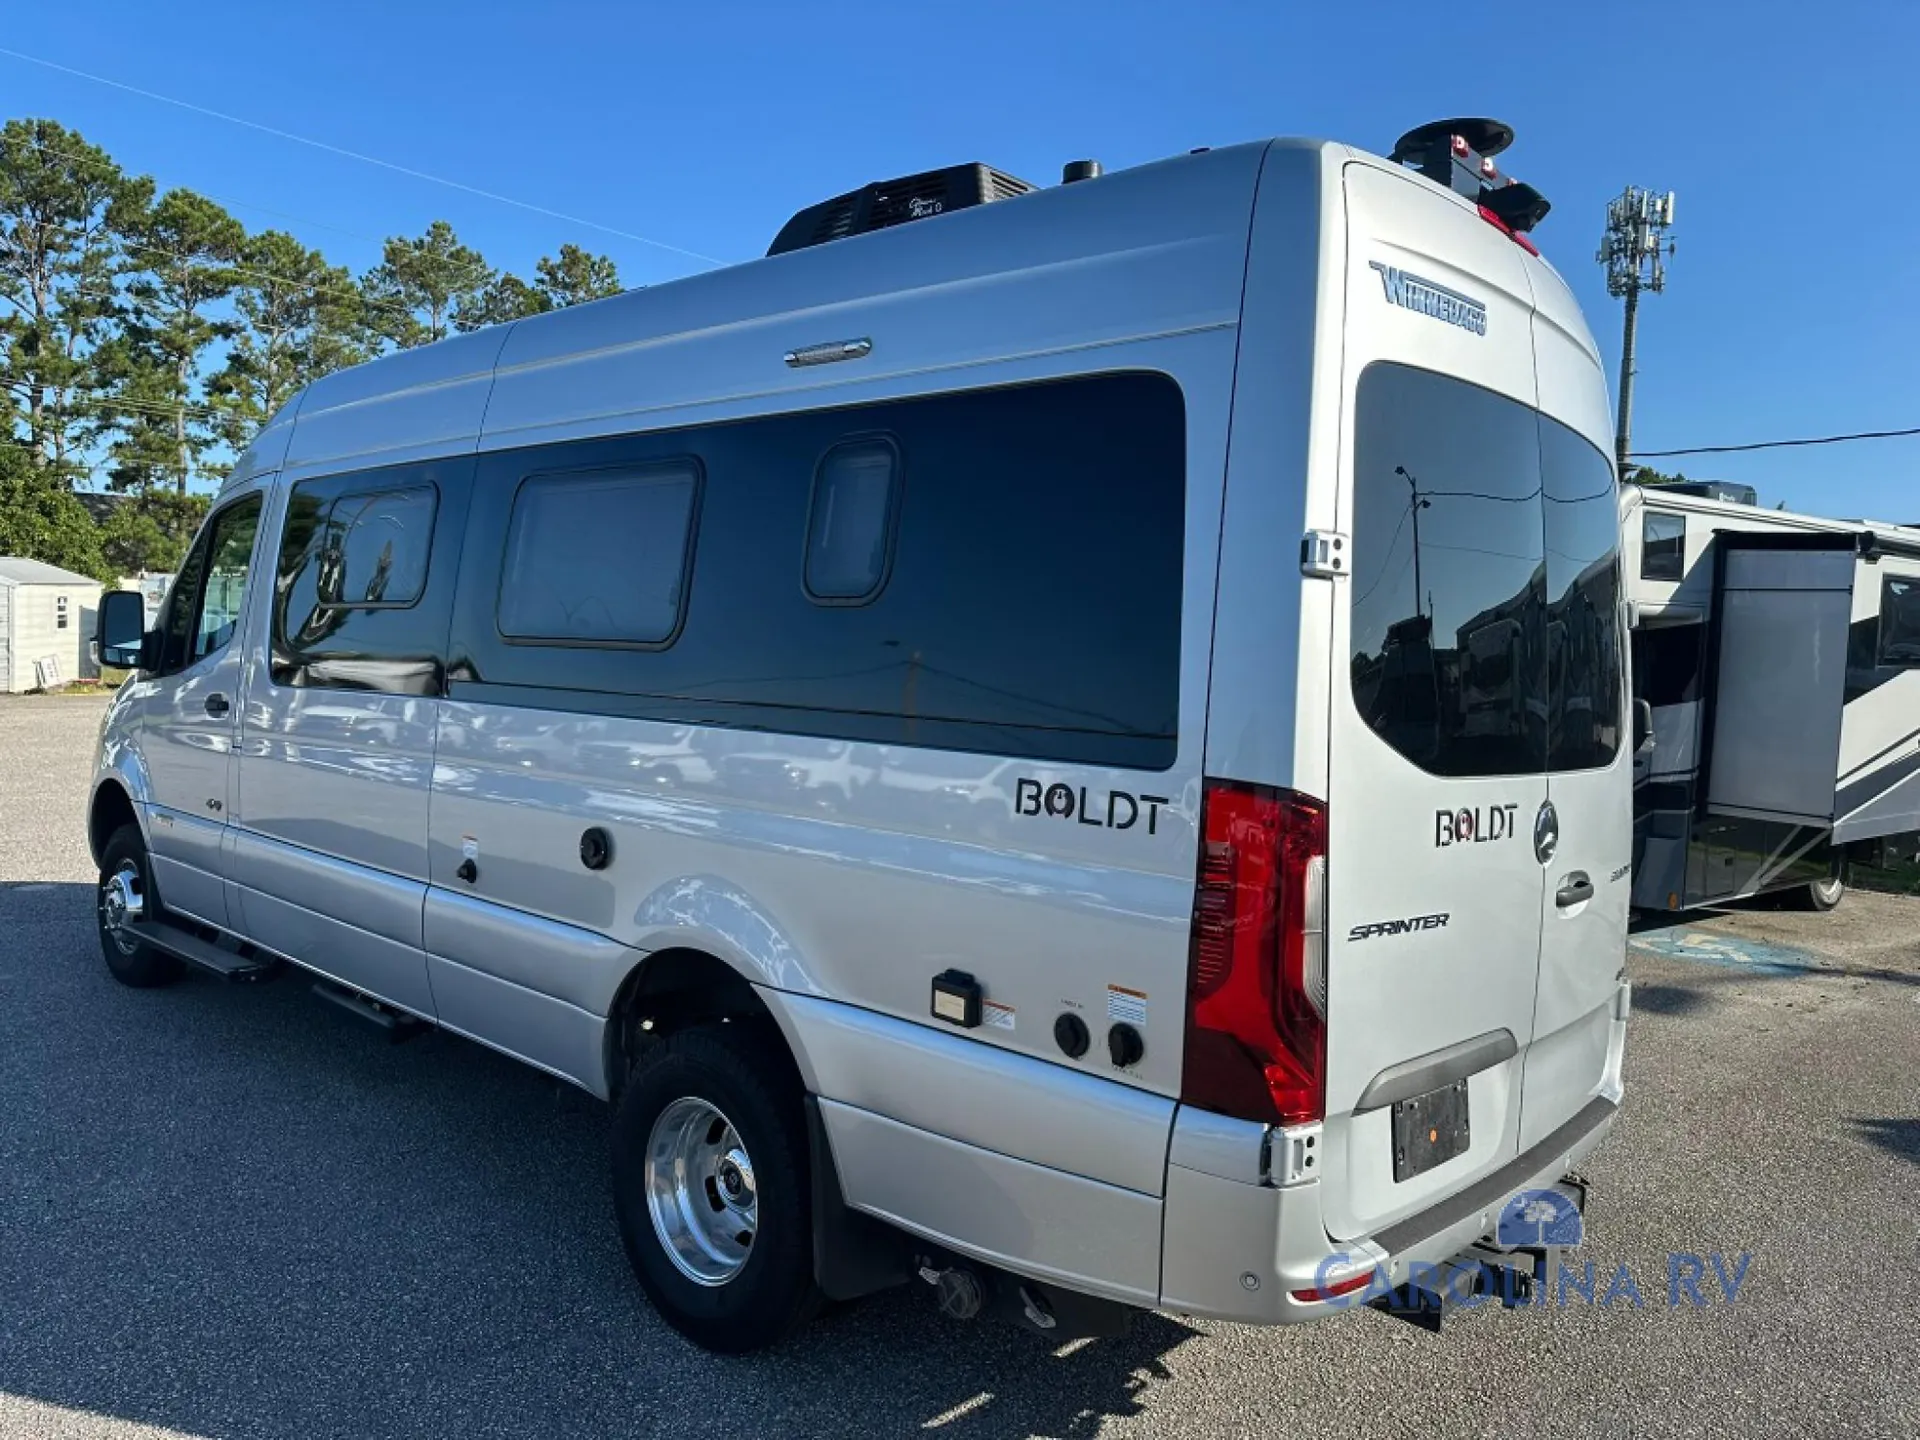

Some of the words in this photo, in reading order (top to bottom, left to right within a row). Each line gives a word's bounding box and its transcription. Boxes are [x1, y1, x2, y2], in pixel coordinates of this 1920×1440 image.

[1368, 260, 1486, 337] WINNEBAGO
[1015, 778, 1169, 835] BOLDT
[1434, 803, 1518, 848] BOLDT
[1347, 912, 1450, 942] SPRINTER
